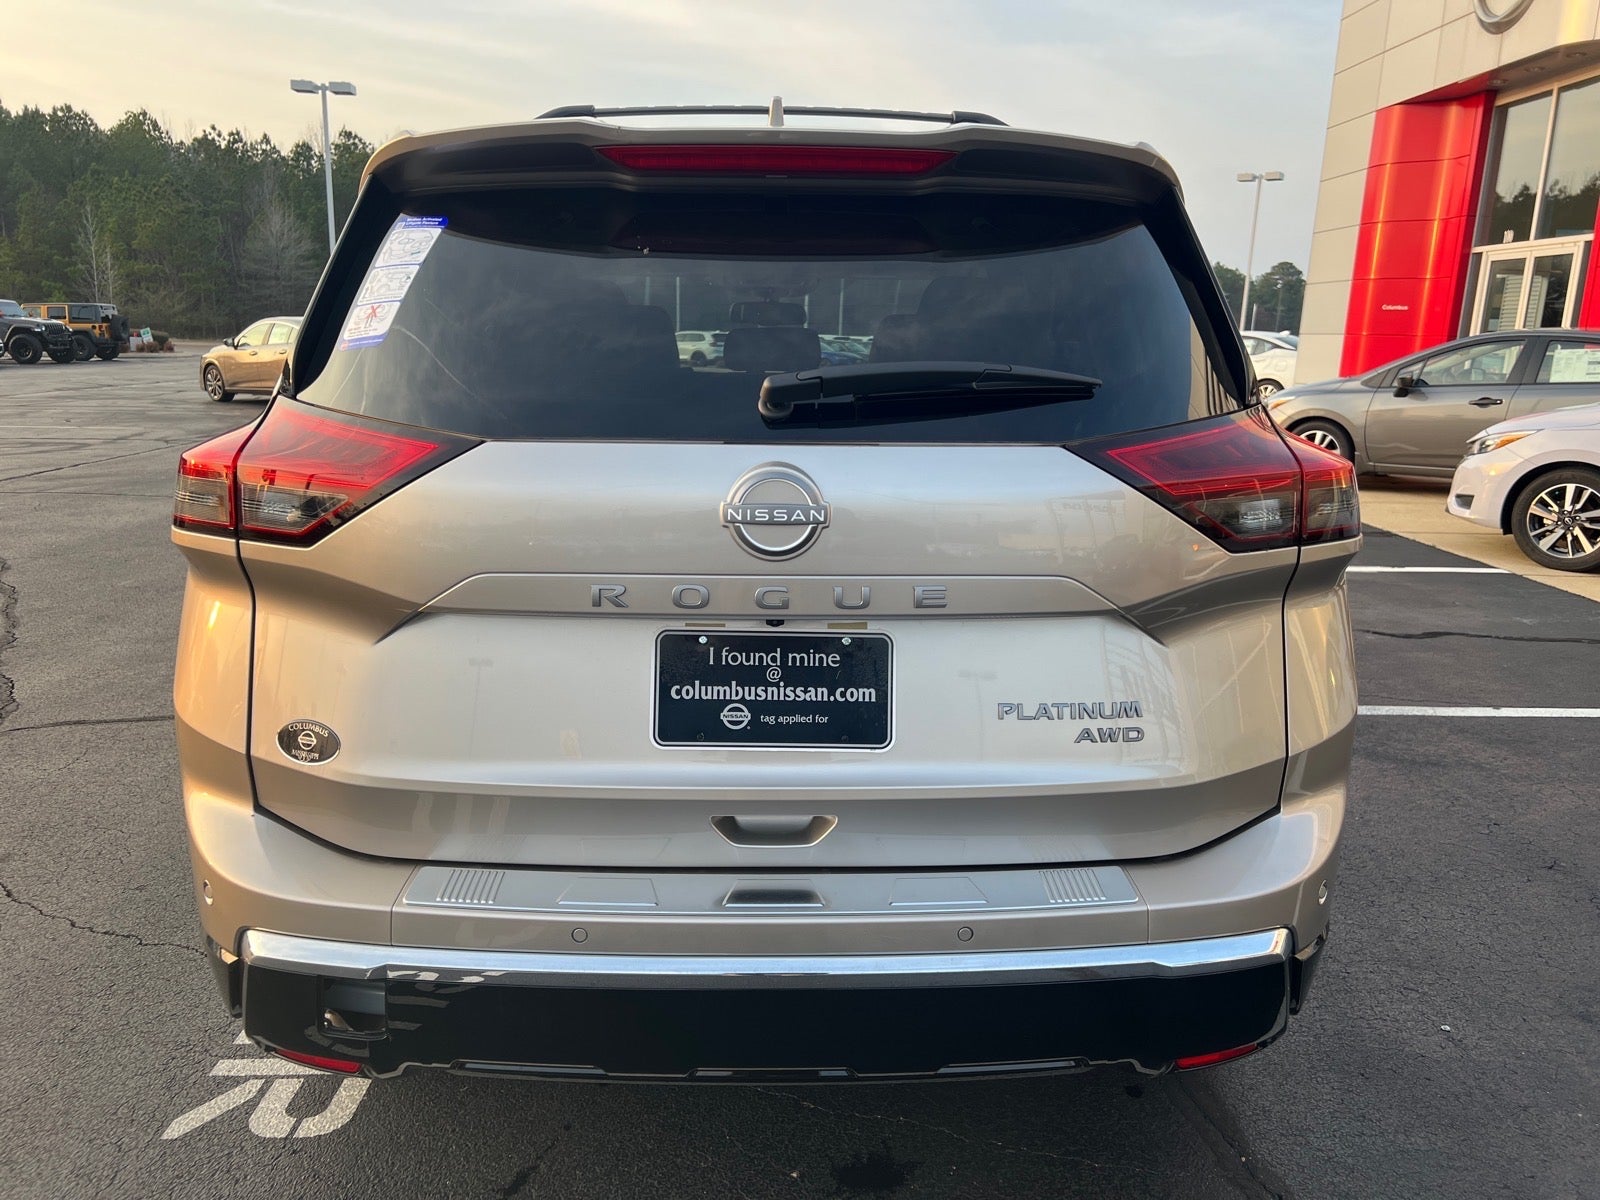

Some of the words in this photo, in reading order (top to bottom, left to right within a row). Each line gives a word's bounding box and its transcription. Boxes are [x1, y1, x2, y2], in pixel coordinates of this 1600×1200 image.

[727, 507, 825, 522] NISSAN
[591, 583, 948, 610] ROGUE
[708, 647, 714, 665] I
[721, 647, 781, 667] found
[788, 648, 841, 667] mine
[766, 667, 782, 682] @
[670, 680, 876, 702] columbusnissan.com
[760, 714, 776, 724] tag
[778, 713, 812, 724] applied
[815, 714, 829, 724] for
[997, 701, 1143, 721] PLATINUM
[288, 723, 329, 737] COLUMBUS
[1074, 726, 1145, 744] AWD
